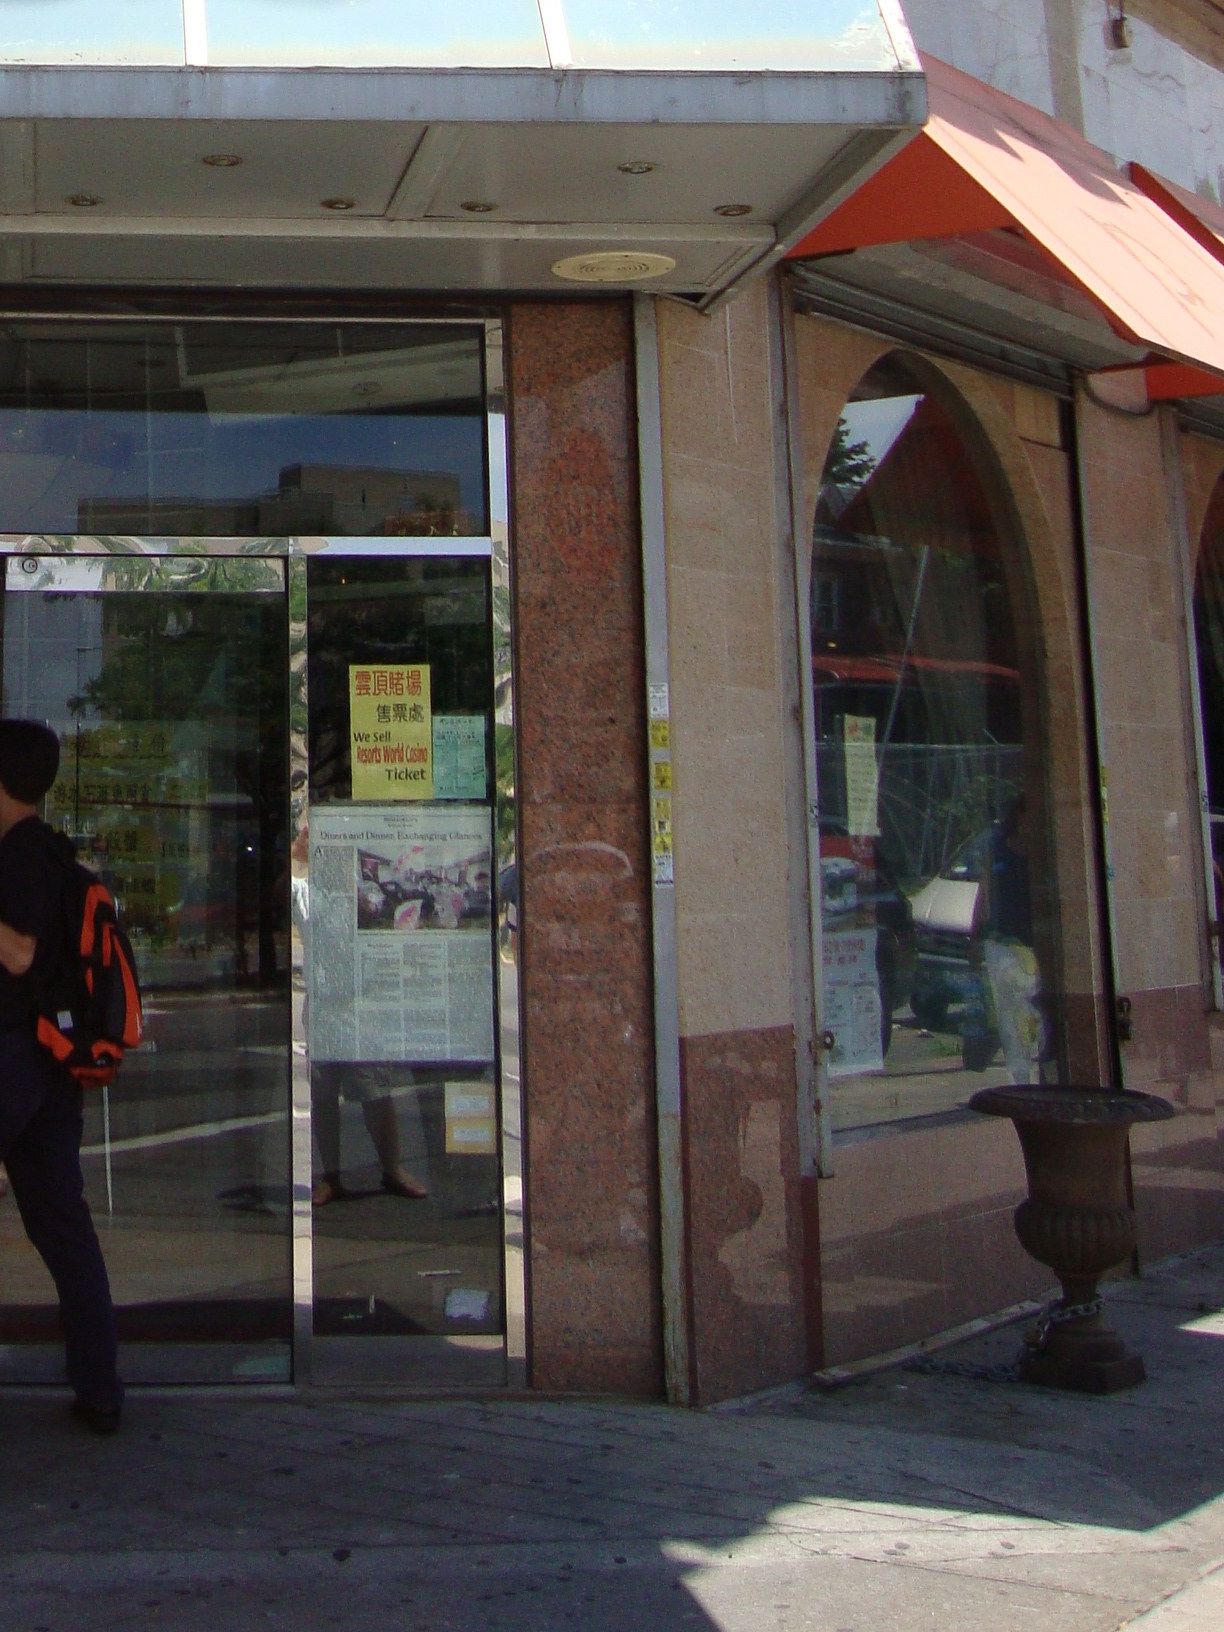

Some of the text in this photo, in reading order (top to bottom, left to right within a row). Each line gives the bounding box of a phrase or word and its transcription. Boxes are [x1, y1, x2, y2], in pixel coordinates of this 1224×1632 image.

[355, 670, 422, 696] 雲頂賭場
[377, 703, 424, 723] 售票處
[353, 731, 391, 743] We Sell
[357, 743, 428, 764] Resorts World Casino
[385, 768, 426, 780] Ticket
